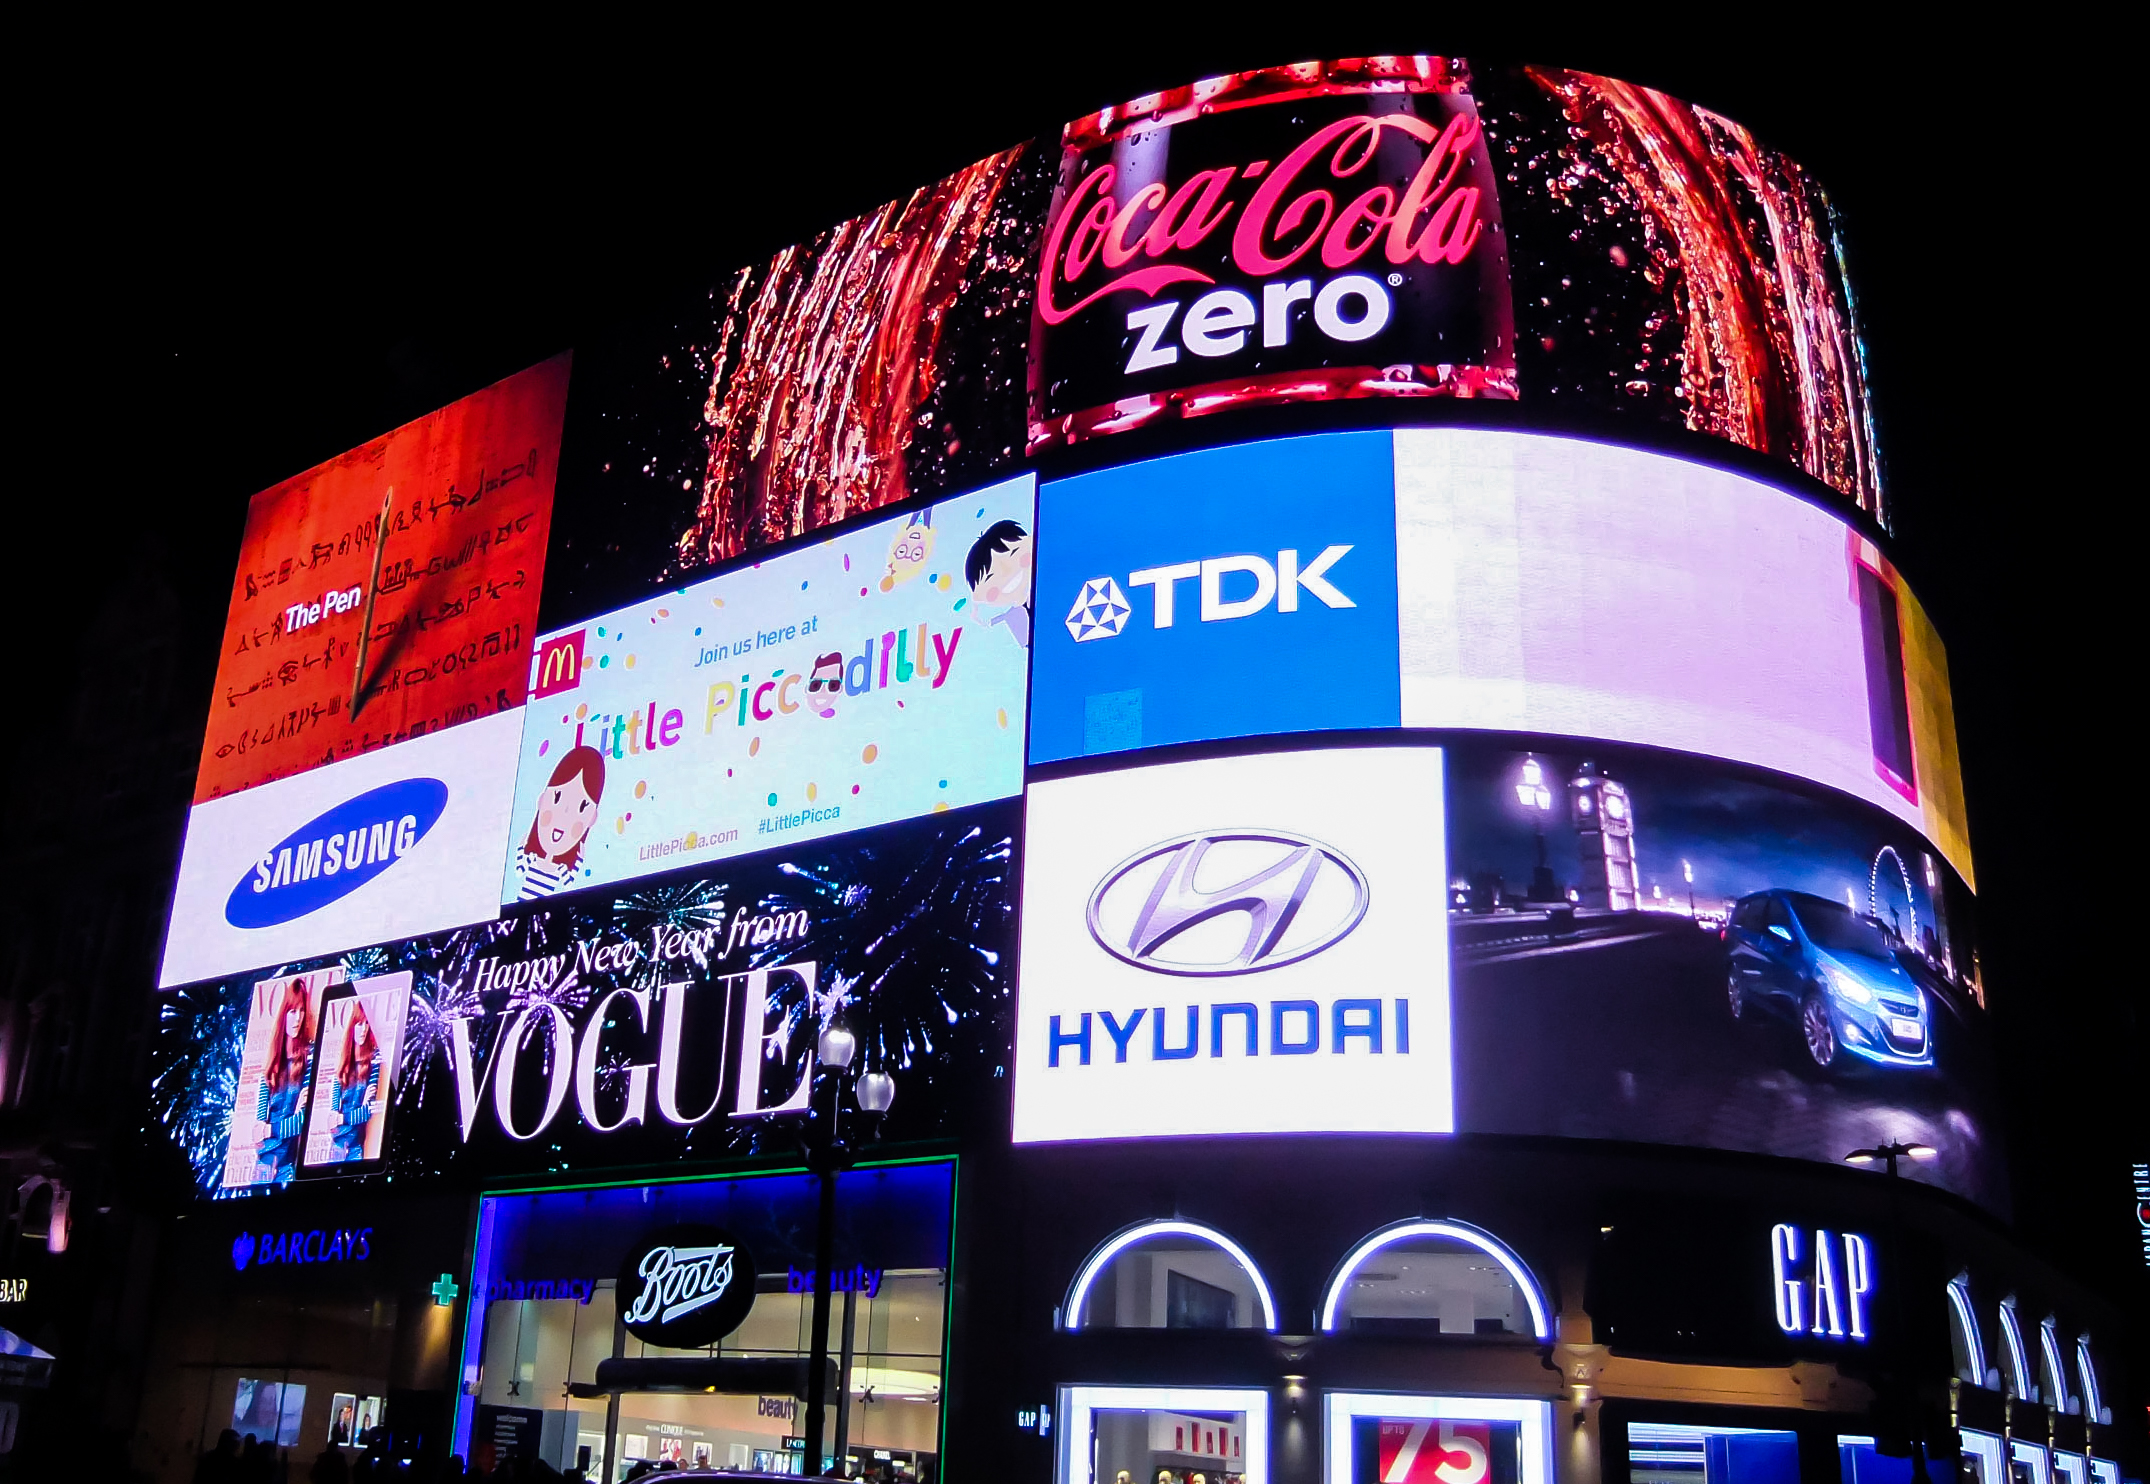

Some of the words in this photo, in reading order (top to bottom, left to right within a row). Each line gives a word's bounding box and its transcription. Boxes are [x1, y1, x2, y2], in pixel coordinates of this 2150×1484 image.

[1038, 112, 1482, 326] Coca-Cola
[1124, 275, 1390, 375] zero
[285, 600, 321, 633] The
[322, 586, 362, 620] Pen
[1129, 544, 1357, 629] TDK
[694, 644, 728, 667] Join
[733, 638, 751, 657] us
[756, 626, 797, 650] here
[801, 615, 818, 635] at
[704, 622, 963, 735] Piccdilly
[253, 814, 417, 893] SAMSUNG
[758, 806, 841, 834] #LittlePicca
[471, 951, 567, 995] Happy
[573, 937, 641, 974] New
[649, 923, 721, 964] Year
[717, 906, 809, 959] from
[451, 961, 817, 1144] VOGUE
[1048, 998, 1409, 1068] HYUNDAI
[257, 1227, 374, 1265] BARCLAYS
[787, 1262, 882, 1298] beuty
[1771, 1223, 1870, 1338] GAP
[0, 1279, 28, 1302] BAR
[487, 1272, 595, 1306] pharmacy
[624, 1243, 735, 1323] Boots
[1018, 1411, 1037, 1427] GAP
[1383, 1419, 1487, 1484] 75
